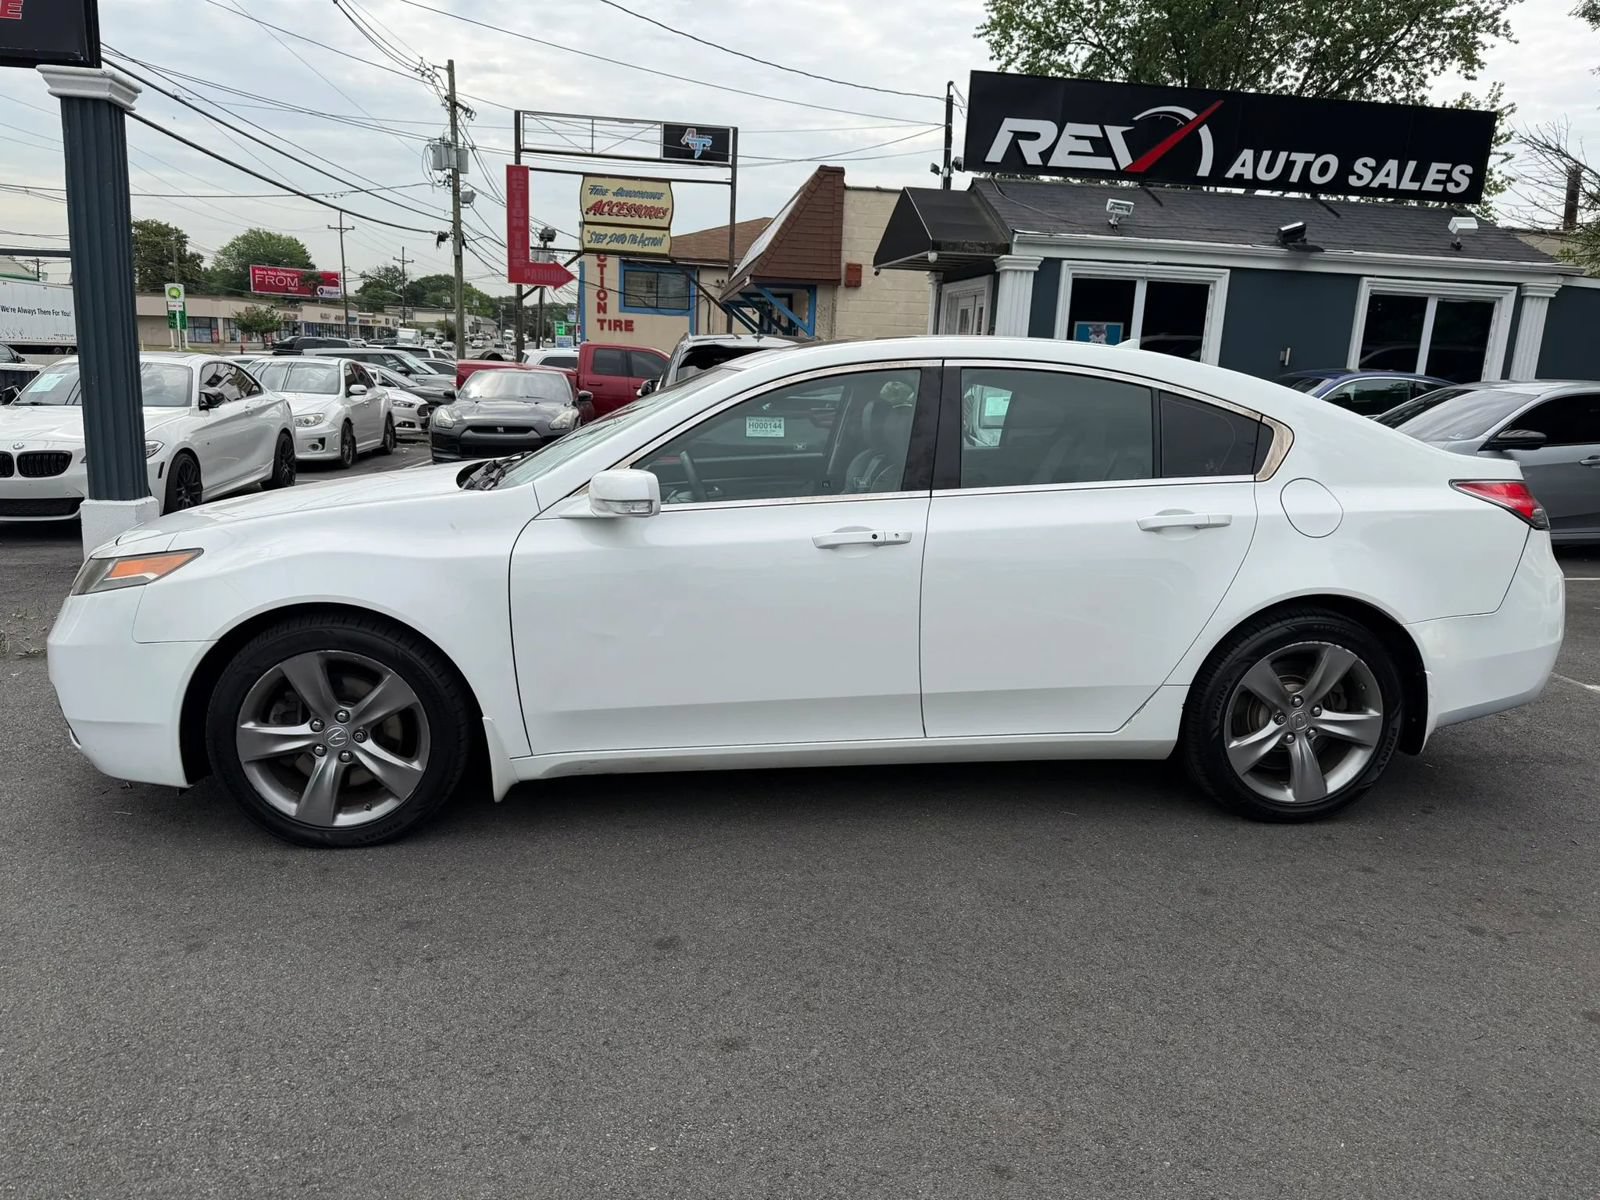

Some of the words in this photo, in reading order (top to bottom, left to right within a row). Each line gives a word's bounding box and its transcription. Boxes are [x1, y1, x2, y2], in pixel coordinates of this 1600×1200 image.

[1224, 148, 1339, 185] AUTO
[1347, 155, 1474, 194] SALES
[585, 199, 670, 219] ACCESSORIES
[255, 274, 299, 287] FROM
[1, 305, 16, 313] We're
[17, 306, 37, 316] Always
[37, 308, 51, 316] There
[597, 318, 635, 332] TIRE
[748, 422, 782, 430] H000144
